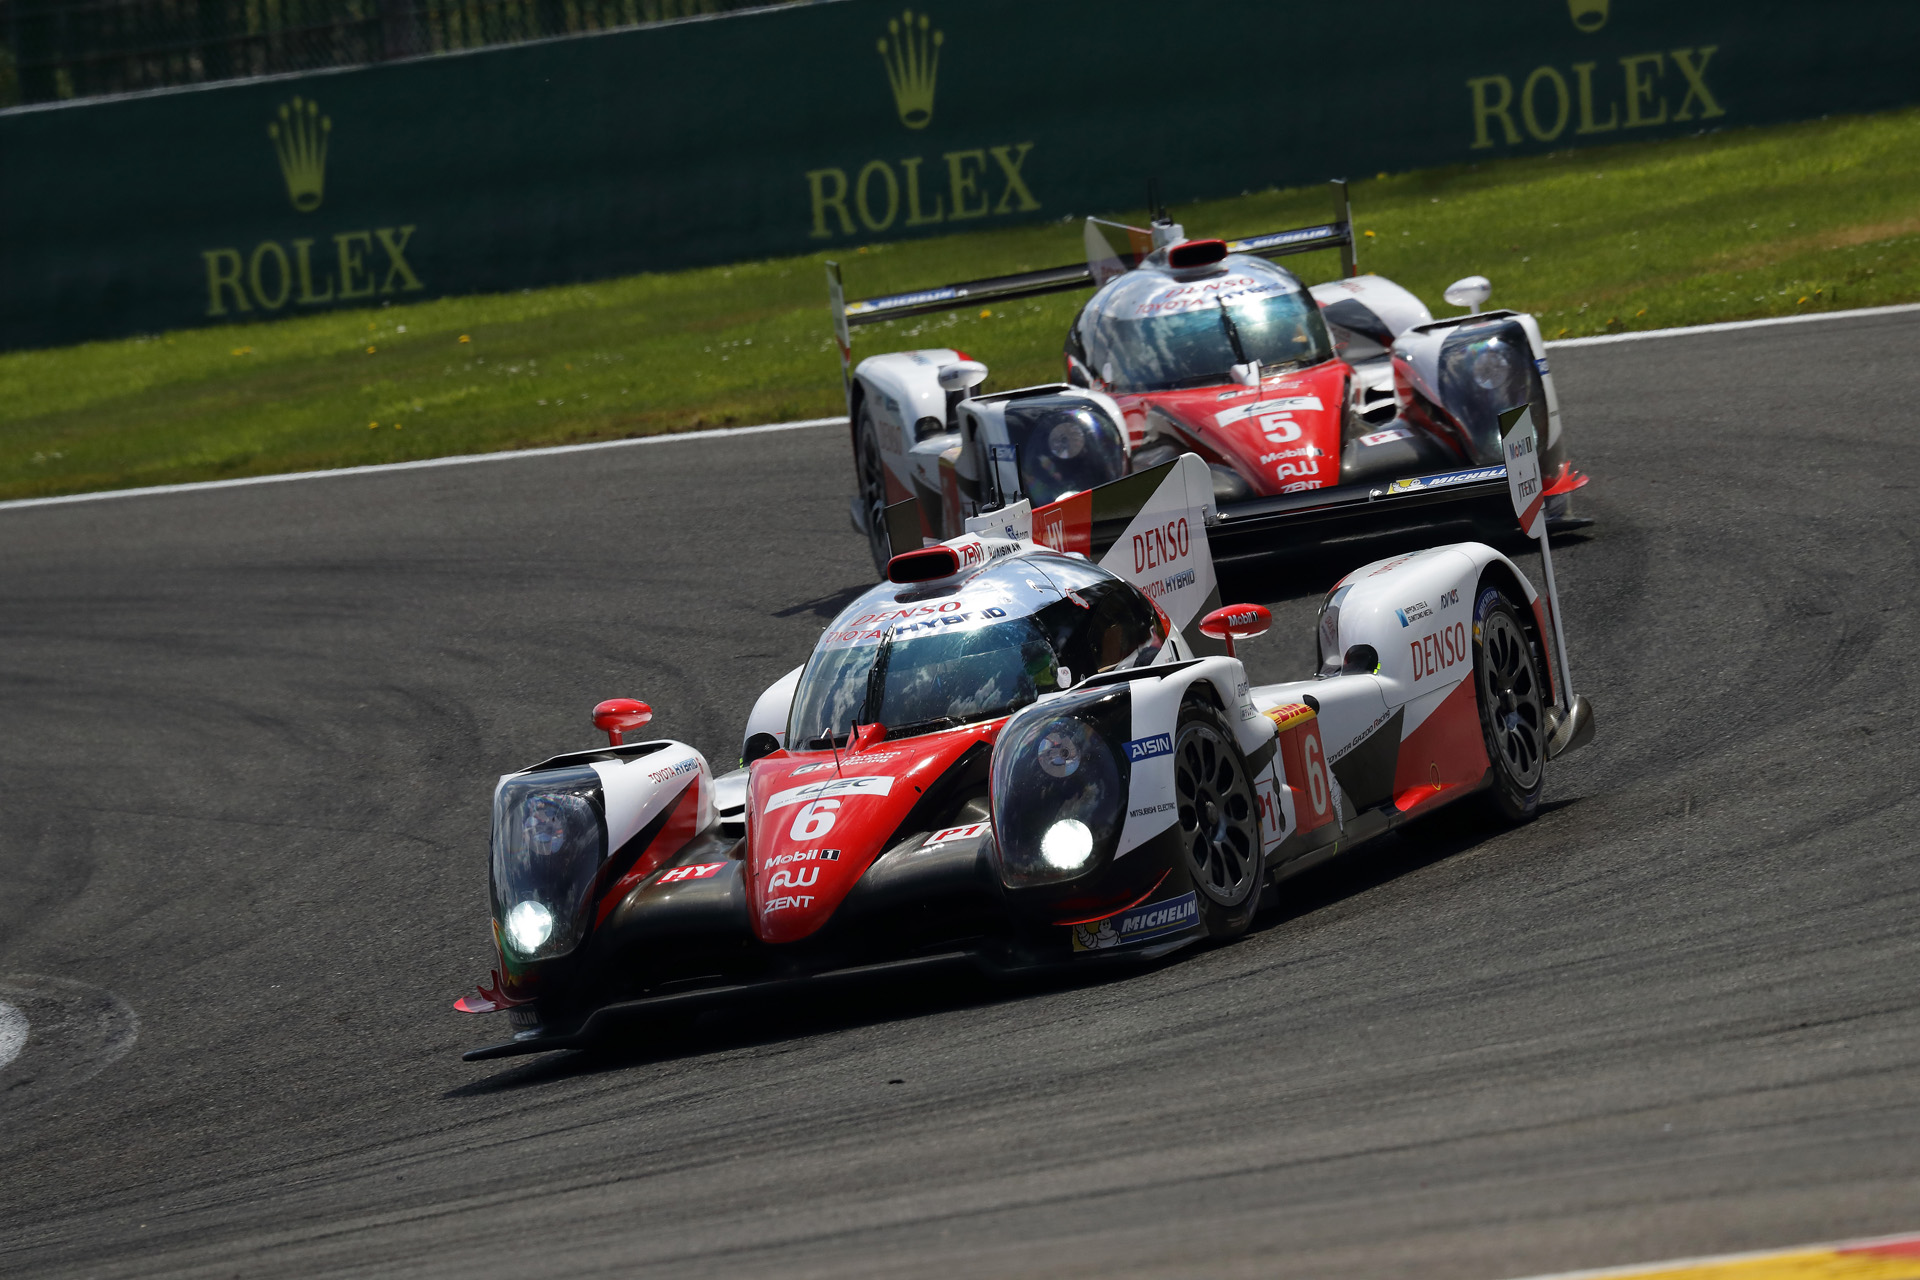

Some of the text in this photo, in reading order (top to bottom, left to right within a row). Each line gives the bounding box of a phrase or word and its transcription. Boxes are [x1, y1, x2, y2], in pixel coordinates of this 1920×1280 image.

[1466, 44, 1727, 151] ROLEX
[806, 142, 1041, 240] ROLEX
[202, 224, 424, 317] ROLEX
[1164, 277, 1255, 299] DENSO
[1136, 298, 1204, 315] TOYOTA
[1258, 411, 1303, 444] 5
[1509, 439, 1527, 460] Mobil
[1281, 479, 1323, 494] ZENT
[1428, 467, 1508, 486] MICHELI
[1046, 519, 1065, 554] HY
[1132, 517, 1189, 575] DENSO
[1165, 567, 1196, 594] HYBRID
[850, 601, 962, 627] DENSO
[1228, 611, 1252, 627] Mobil
[824, 629, 882, 645] TOYOTA
[1410, 621, 1466, 682] DENSO
[1270, 703, 1309, 724] DHL
[1352, 724, 1374, 747] GAZOO
[1131, 736, 1170, 759] AISIN
[648, 757, 698, 785] TOYOTA HYBRID
[1304, 734, 1327, 816] 6
[789, 798, 841, 842] 6
[1129, 802, 1176, 818] MITSUBISHI ELECTRIC
[934, 824, 982, 842] P1
[763, 849, 819, 870] Mobil
[660, 863, 722, 882] HY
[763, 895, 815, 915] ZENT
[1121, 899, 1196, 933] MICHELIN
